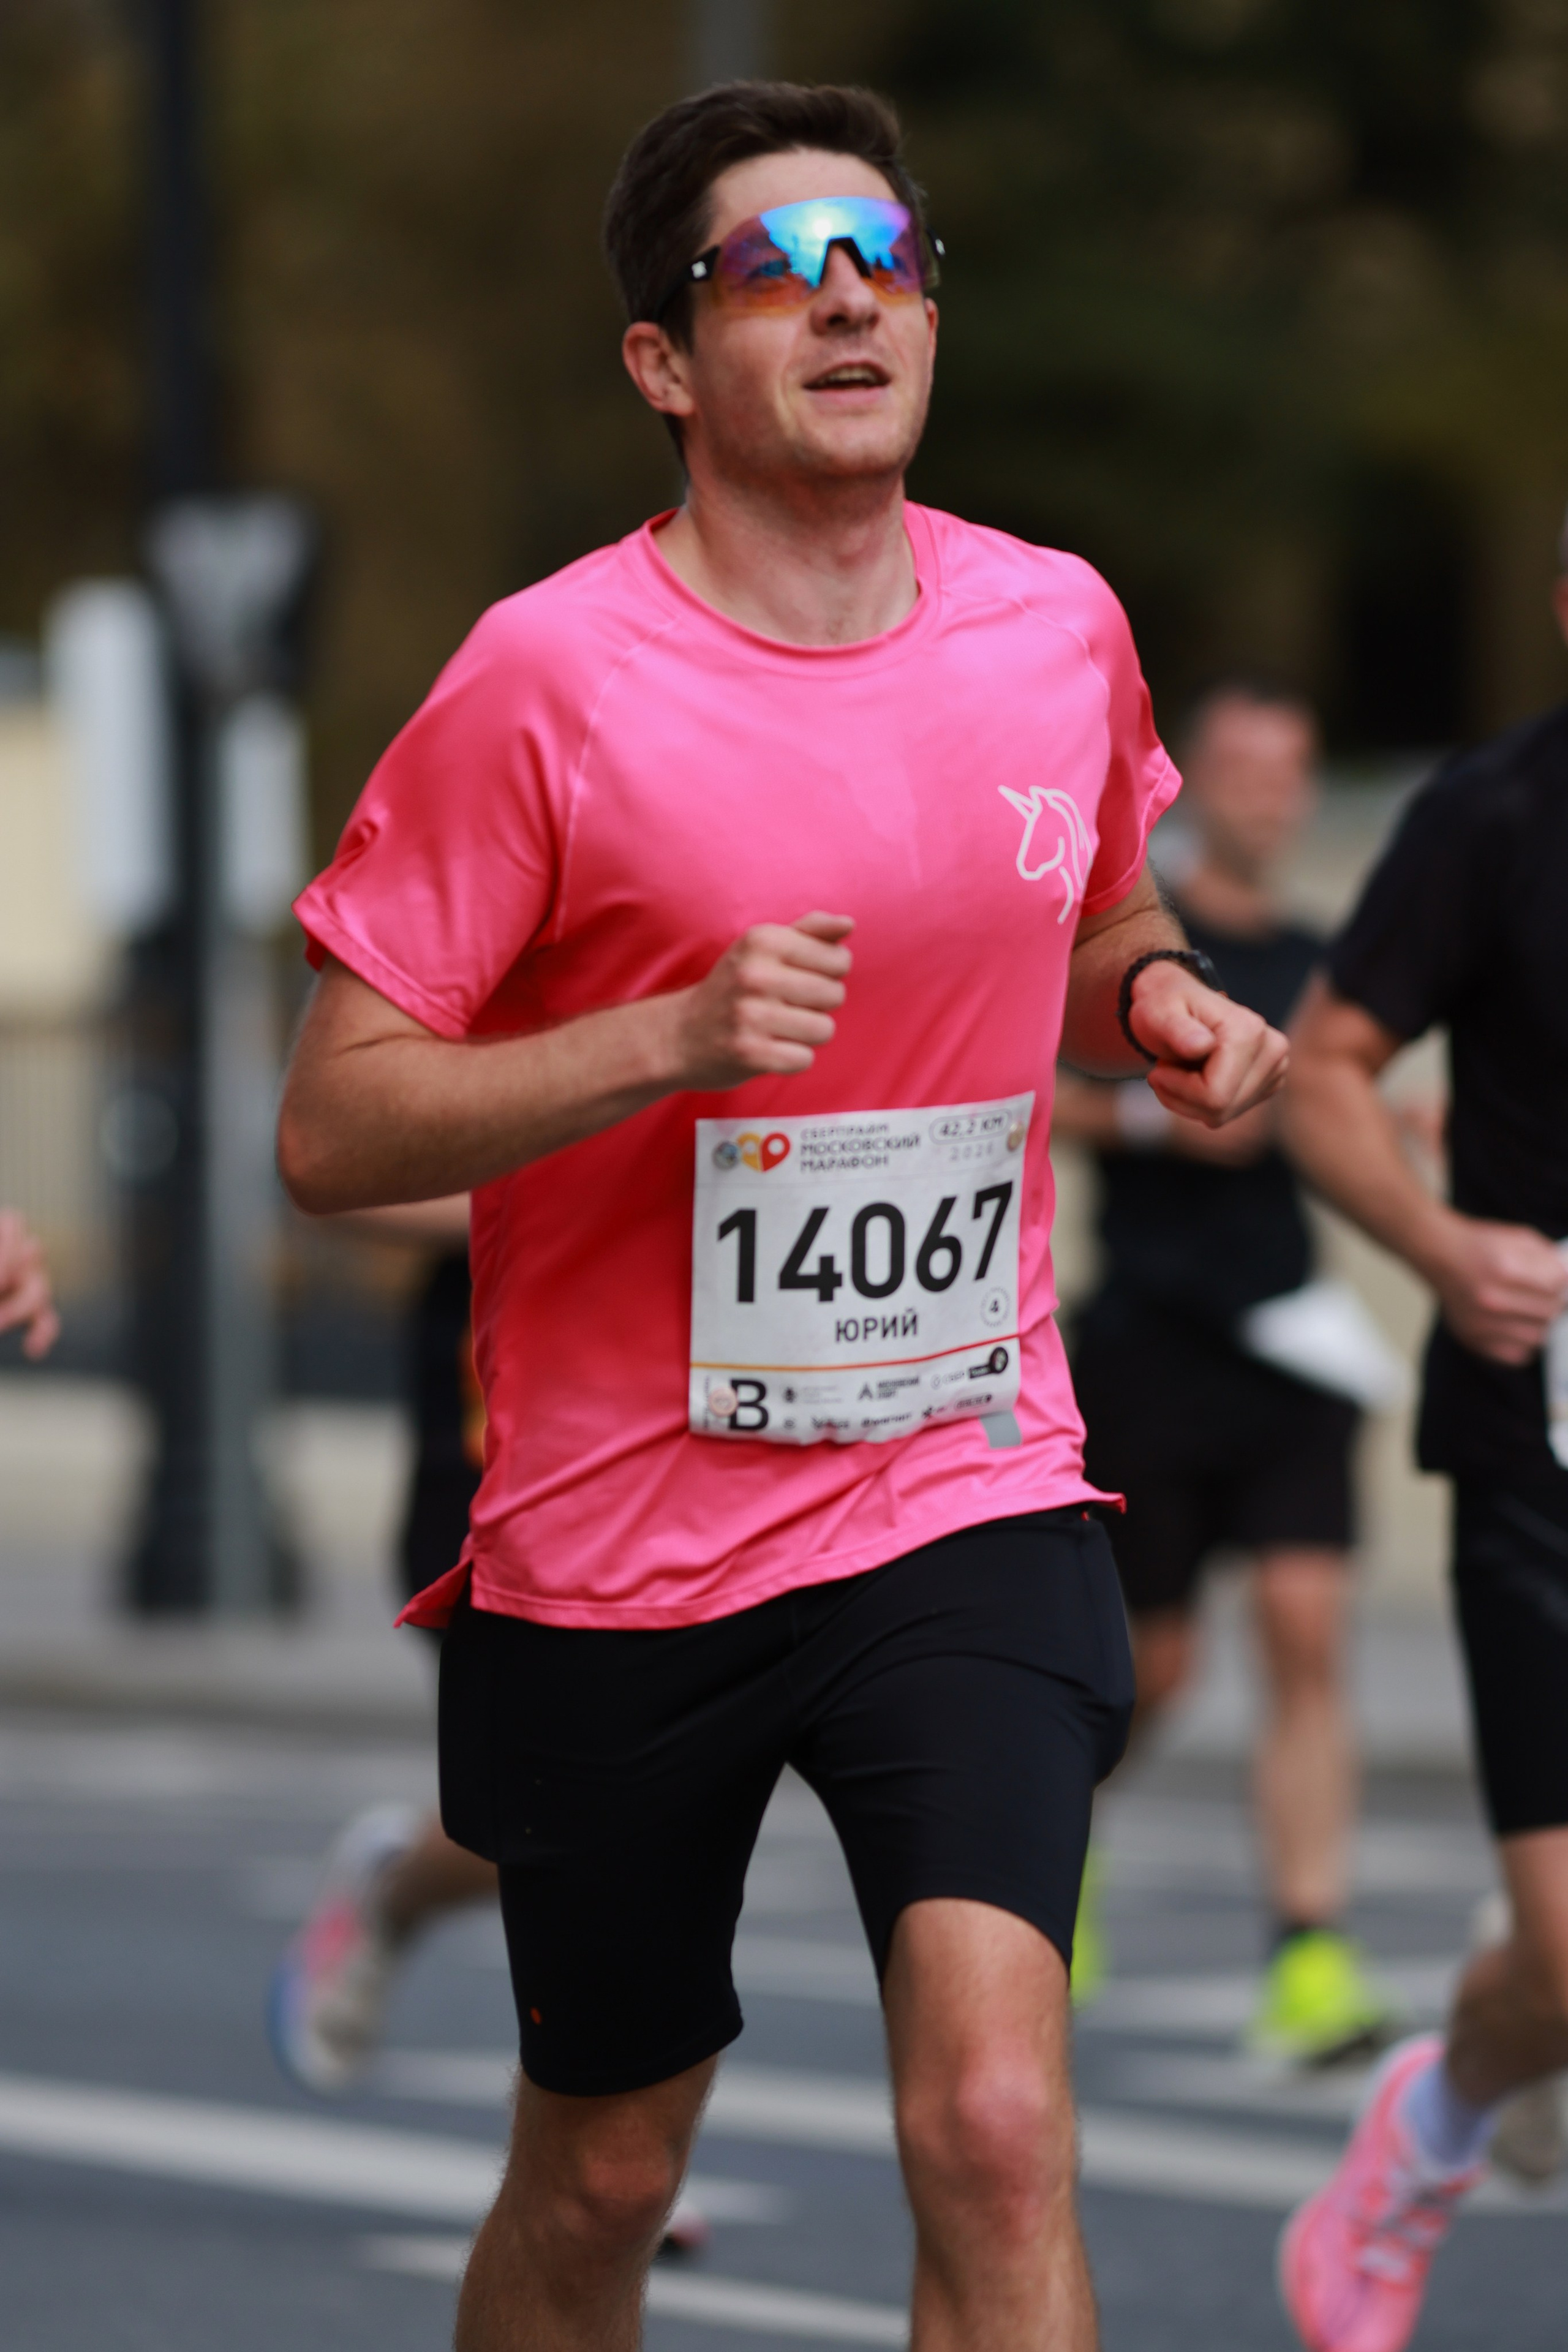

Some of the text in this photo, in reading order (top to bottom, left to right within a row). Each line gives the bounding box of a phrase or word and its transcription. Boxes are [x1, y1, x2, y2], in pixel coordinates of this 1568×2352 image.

[799, 1133, 921, 1156] МОСКОВСКИЙ
[799, 1153, 889, 1174] МАРАФОН
[716, 1180, 1014, 1304] 14067
[989, 1298, 999, 1313] 4
[835, 1308, 918, 1343] ЮРИЙ
